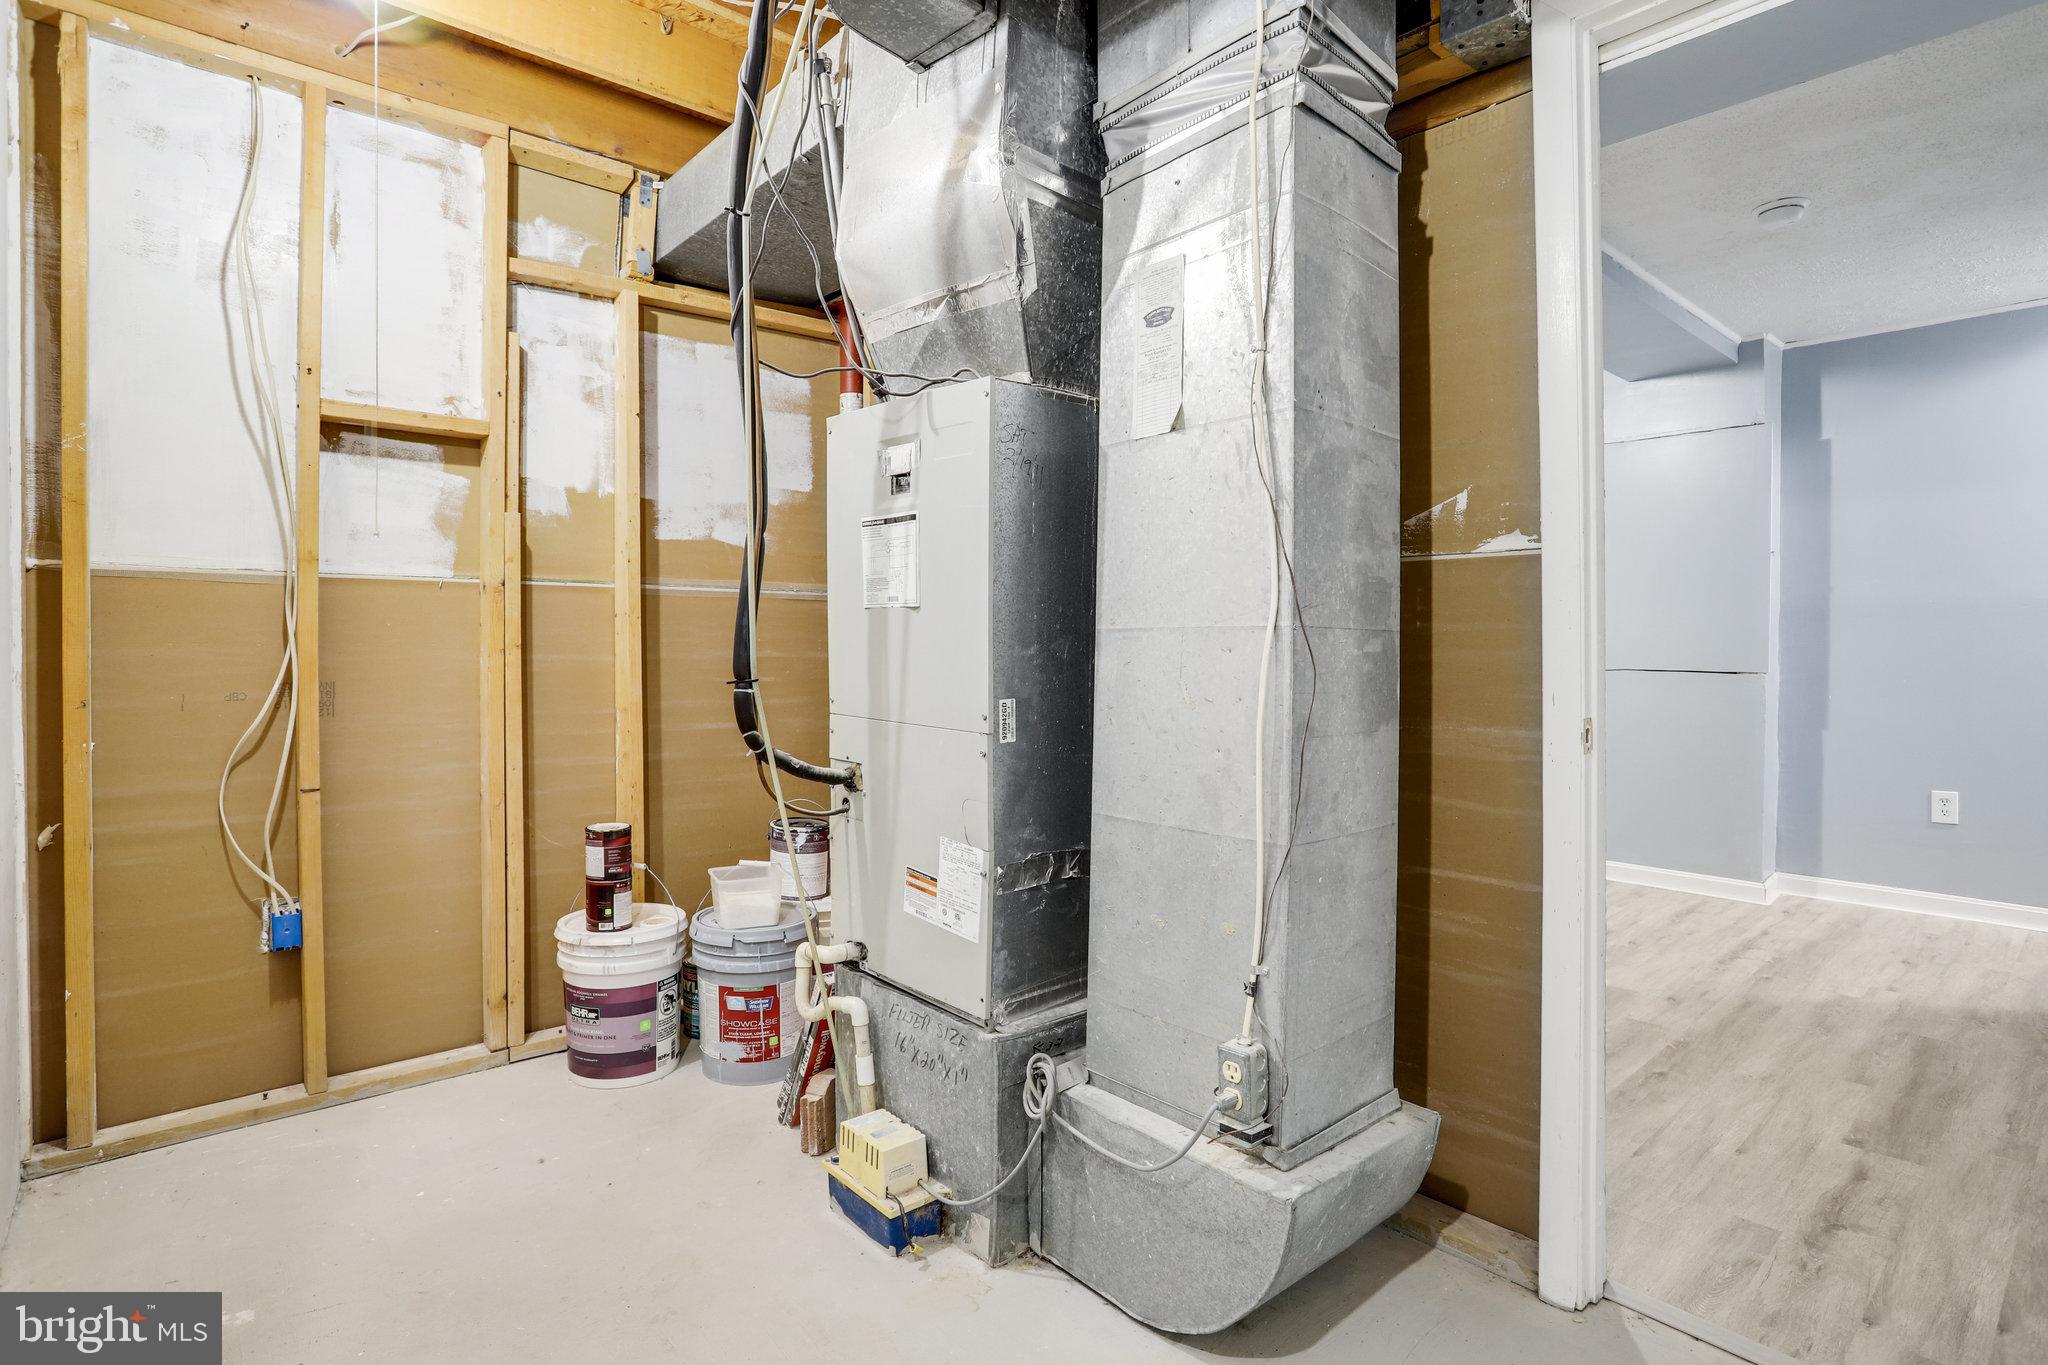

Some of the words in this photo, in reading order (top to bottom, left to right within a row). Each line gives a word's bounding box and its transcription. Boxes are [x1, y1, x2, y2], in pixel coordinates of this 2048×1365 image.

[1000, 423, 1035, 446] SAT
[571, 1006, 589, 1019] BEHR
[720, 1018, 778, 1027] SHOWCASE
[889, 1003, 932, 1032] FILTER
[936, 1023, 968, 1048] SIZE
[811, 1030, 830, 1077] oneywell
